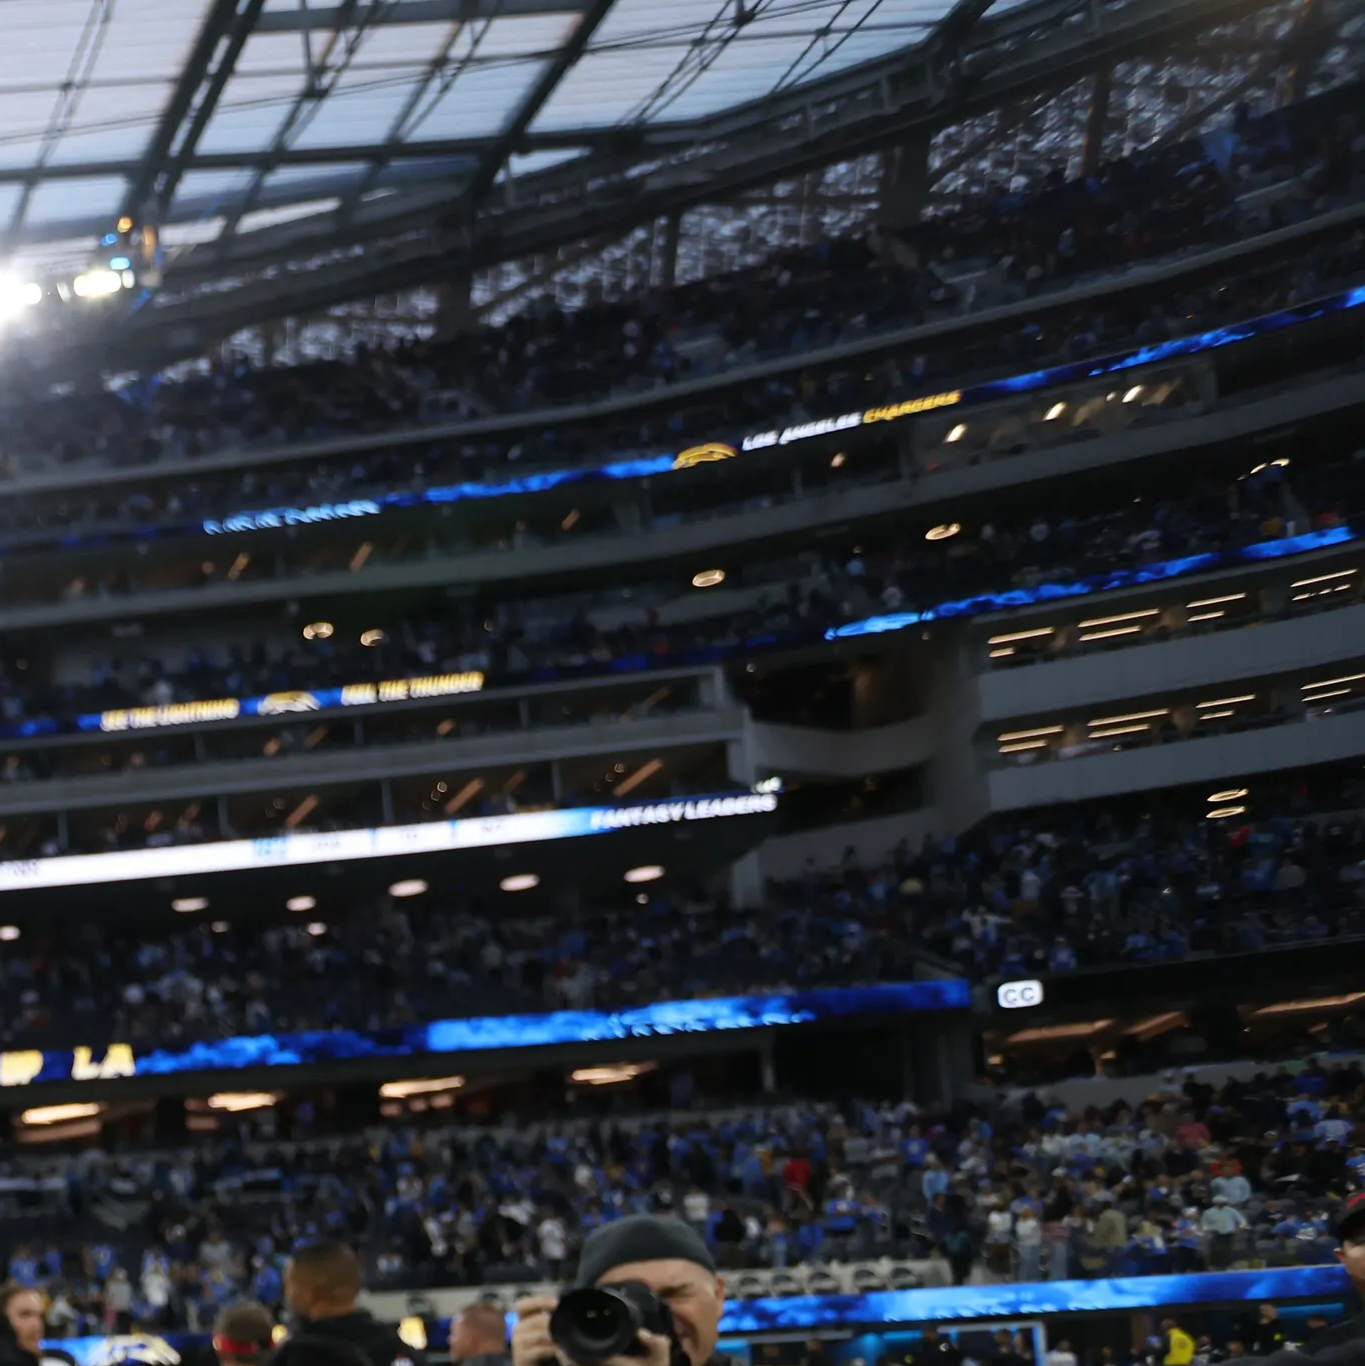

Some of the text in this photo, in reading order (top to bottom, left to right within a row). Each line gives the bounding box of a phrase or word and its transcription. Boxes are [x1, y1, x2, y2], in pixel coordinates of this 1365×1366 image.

[863, 389, 963, 424] CHARGERS
[590, 793, 777, 830] FANTASY LEADERS
[72, 1043, 136, 1080] LA
